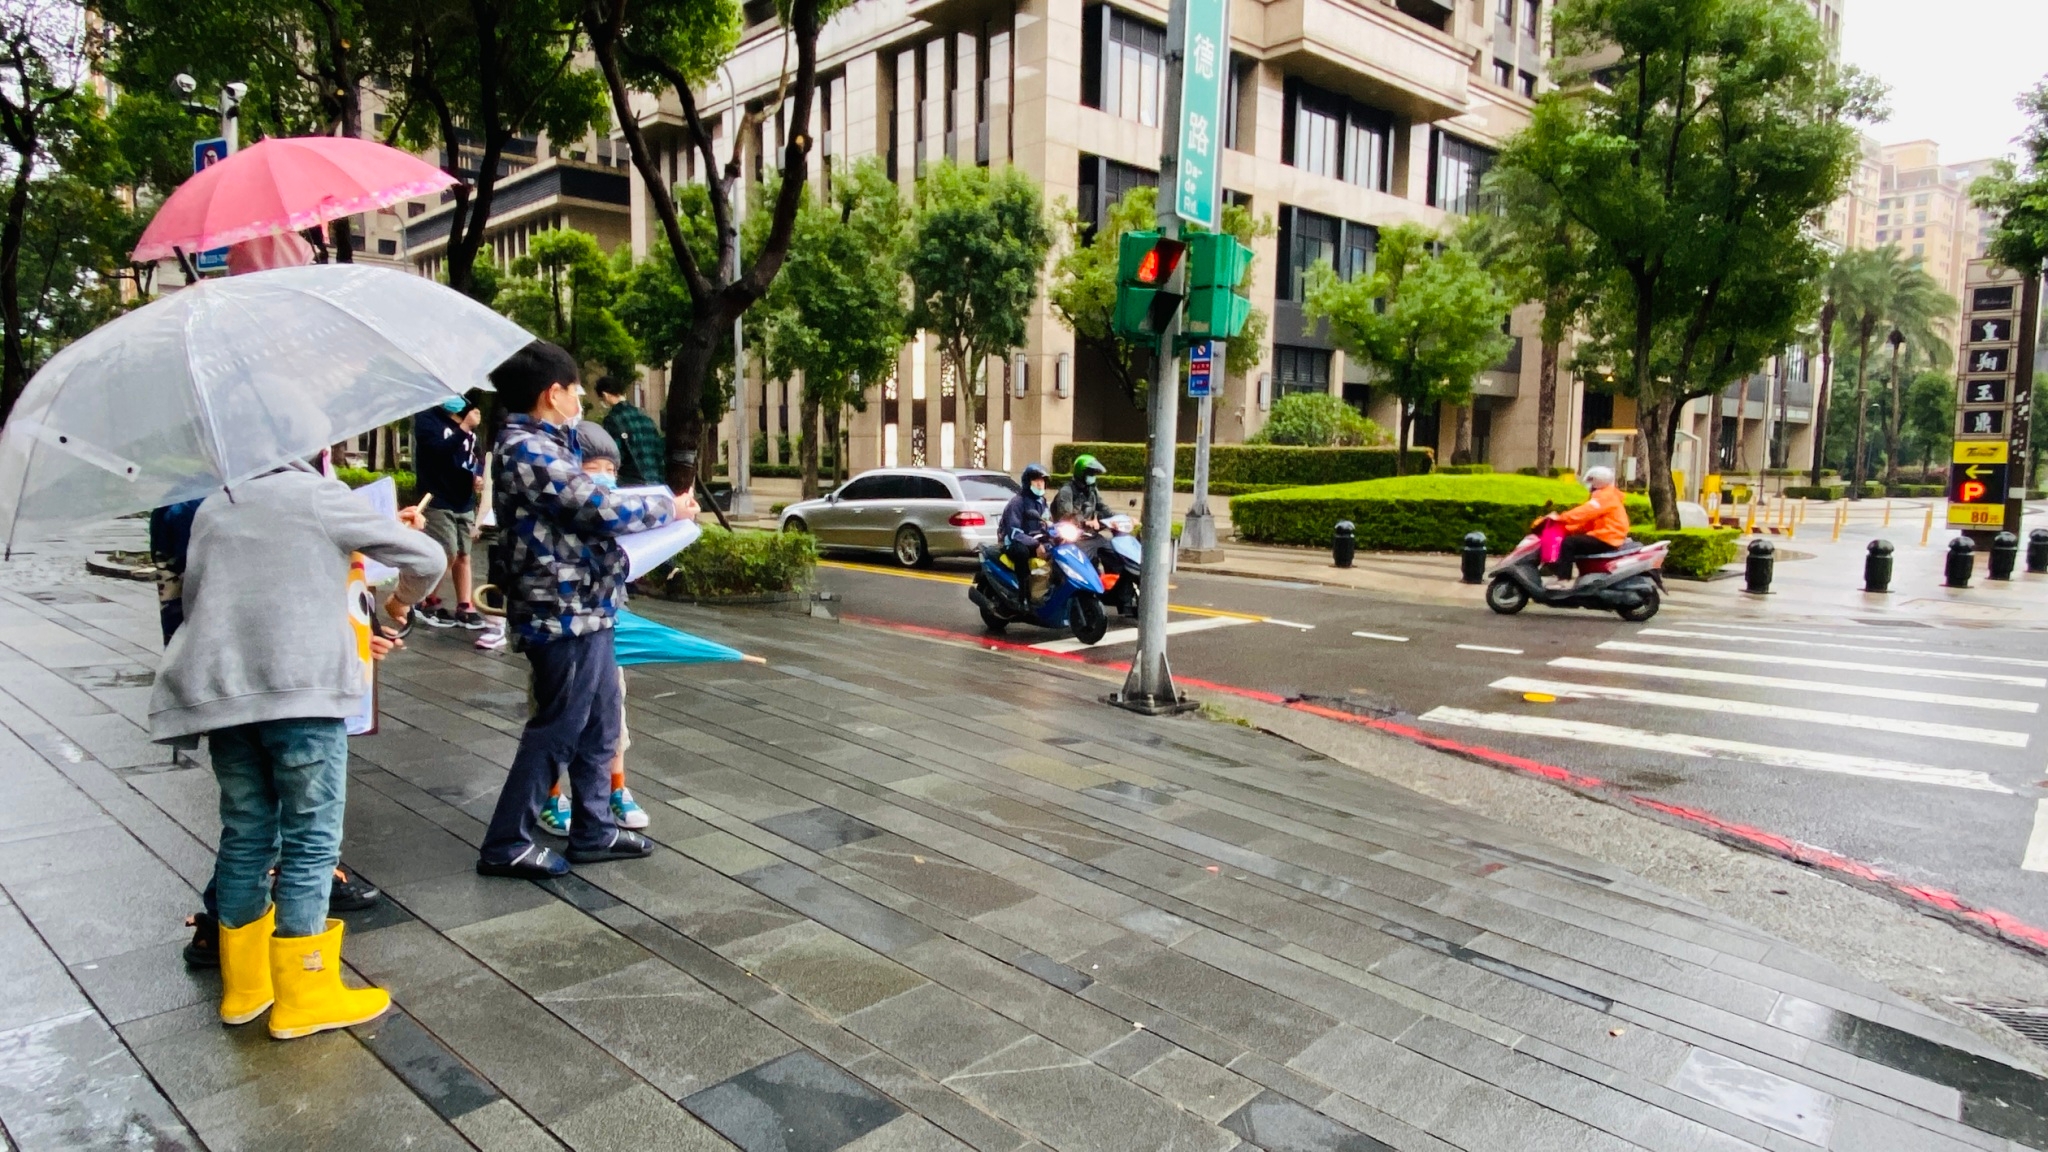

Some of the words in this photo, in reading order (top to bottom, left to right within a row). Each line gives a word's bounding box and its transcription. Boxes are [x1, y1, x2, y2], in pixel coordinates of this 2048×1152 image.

[1185, 158, 1203, 178] Da-
[1184, 178, 1196, 195] de
[1183, 195, 1199, 216] Rd.
[1961, 481, 1986, 502] P
